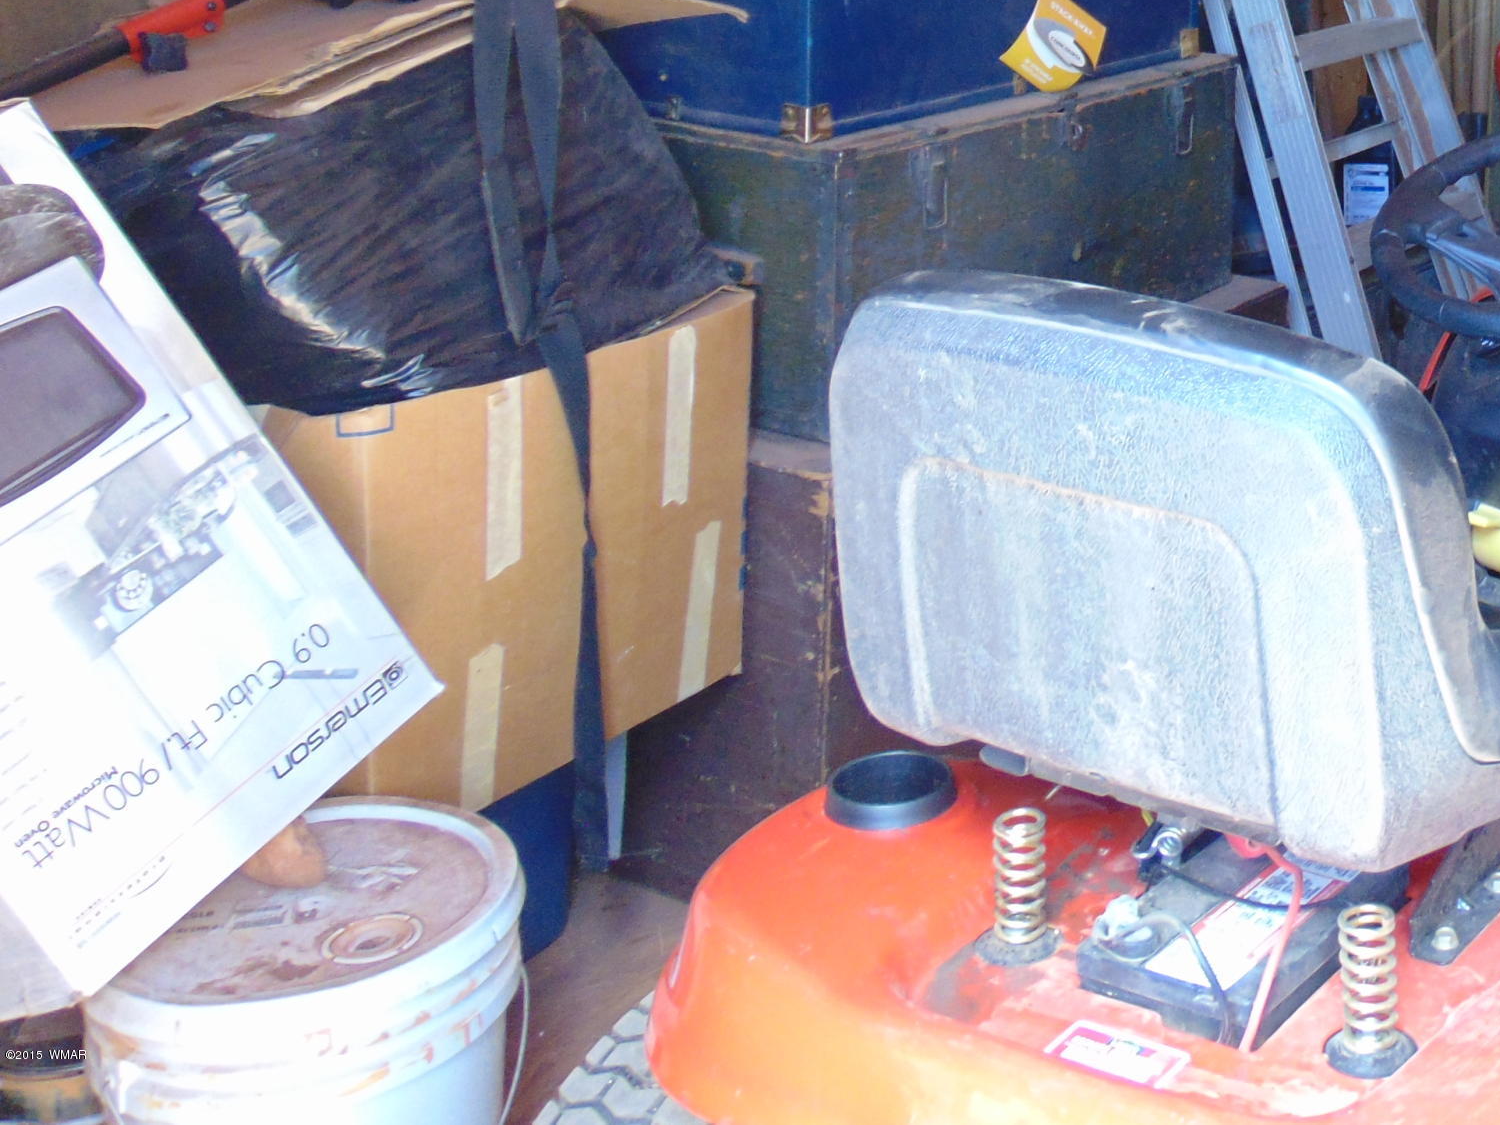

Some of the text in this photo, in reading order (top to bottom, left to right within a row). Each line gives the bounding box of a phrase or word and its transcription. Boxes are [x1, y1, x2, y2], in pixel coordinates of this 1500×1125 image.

[292, 623, 330, 664] 0.9
[205, 659, 286, 723] Cubic
[271, 677, 389, 780] Emerson
[14, 766, 119, 849] Microwave Oven
[103, 758, 160, 811] 900
[22, 804, 111, 869] Watt
